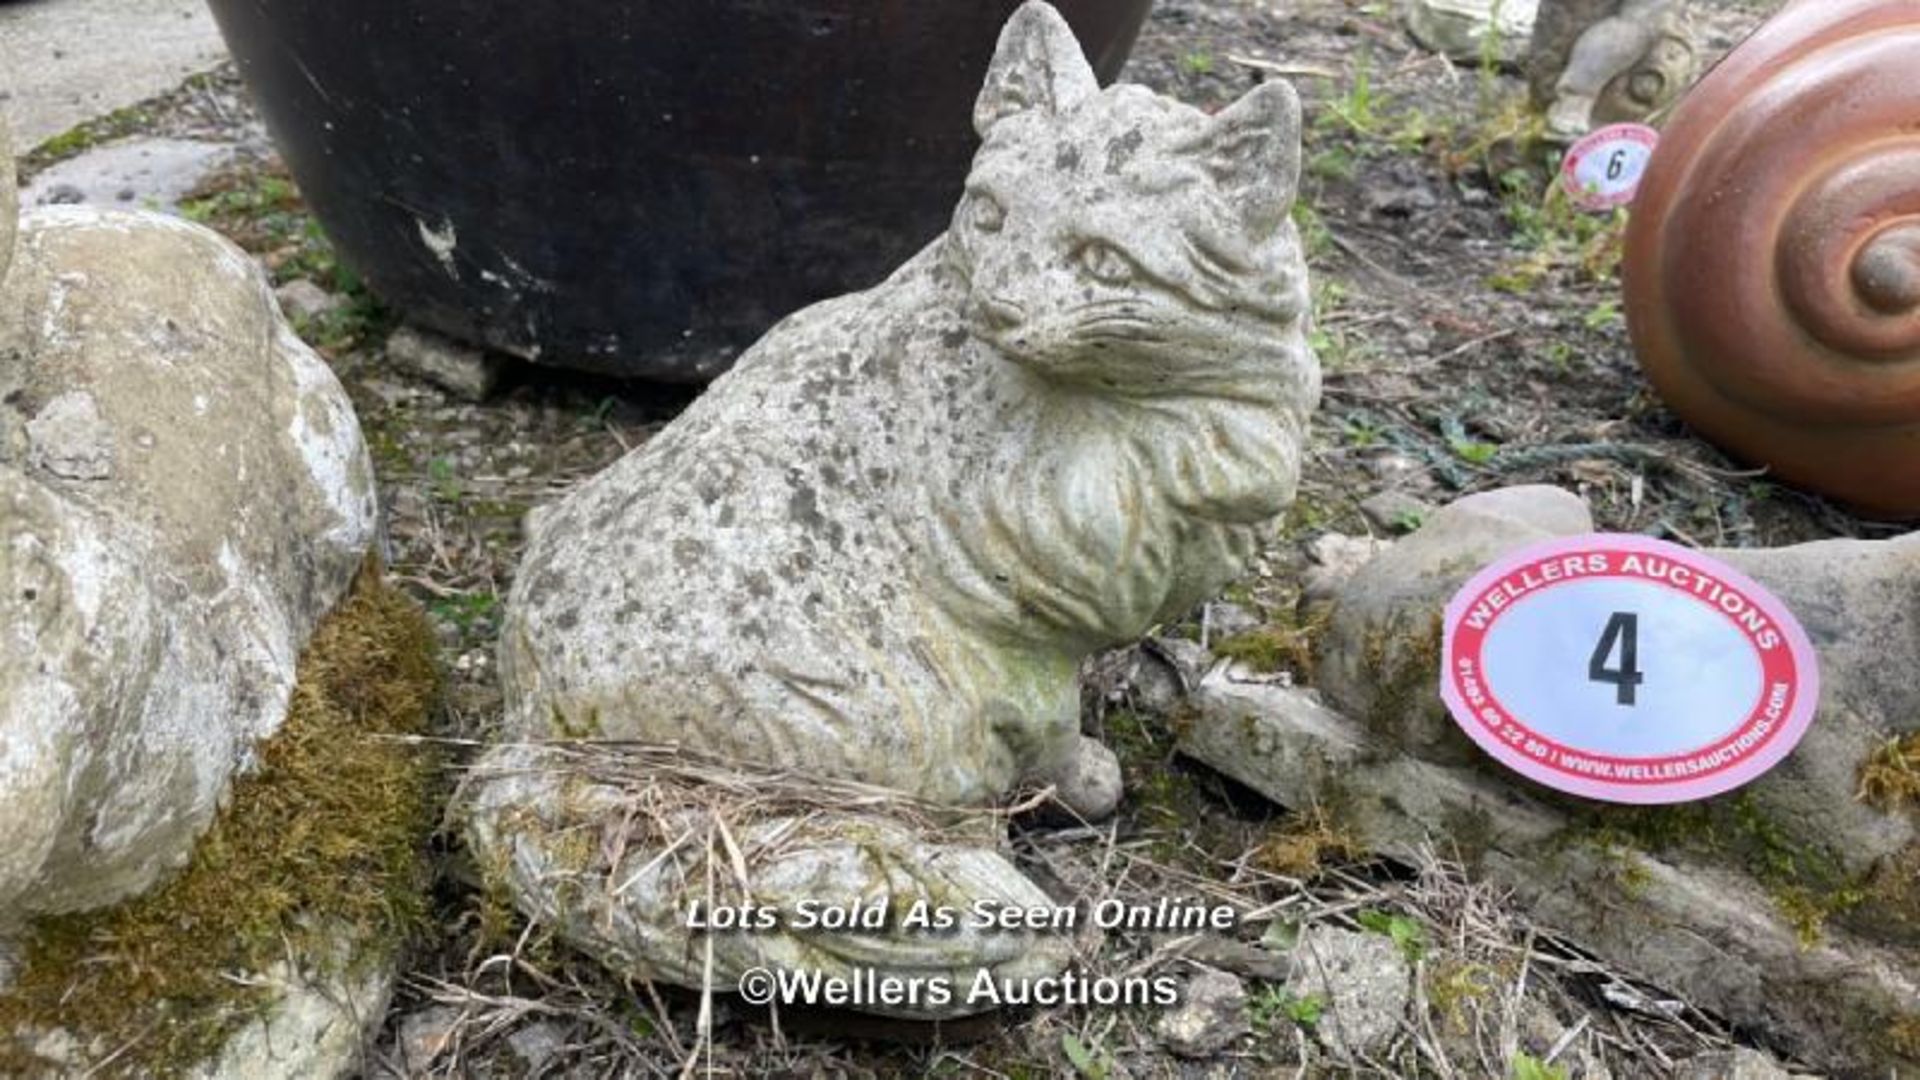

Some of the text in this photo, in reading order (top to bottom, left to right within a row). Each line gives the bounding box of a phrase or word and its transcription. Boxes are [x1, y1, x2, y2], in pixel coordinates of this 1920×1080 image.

[1606, 149, 1626, 181] 6
[1467, 553, 1780, 651] WELLERS AUCTIONS
[1588, 611, 1643, 707] 4
[1560, 682, 1789, 780] WWW.WELLERSAUCTIONS.COM
